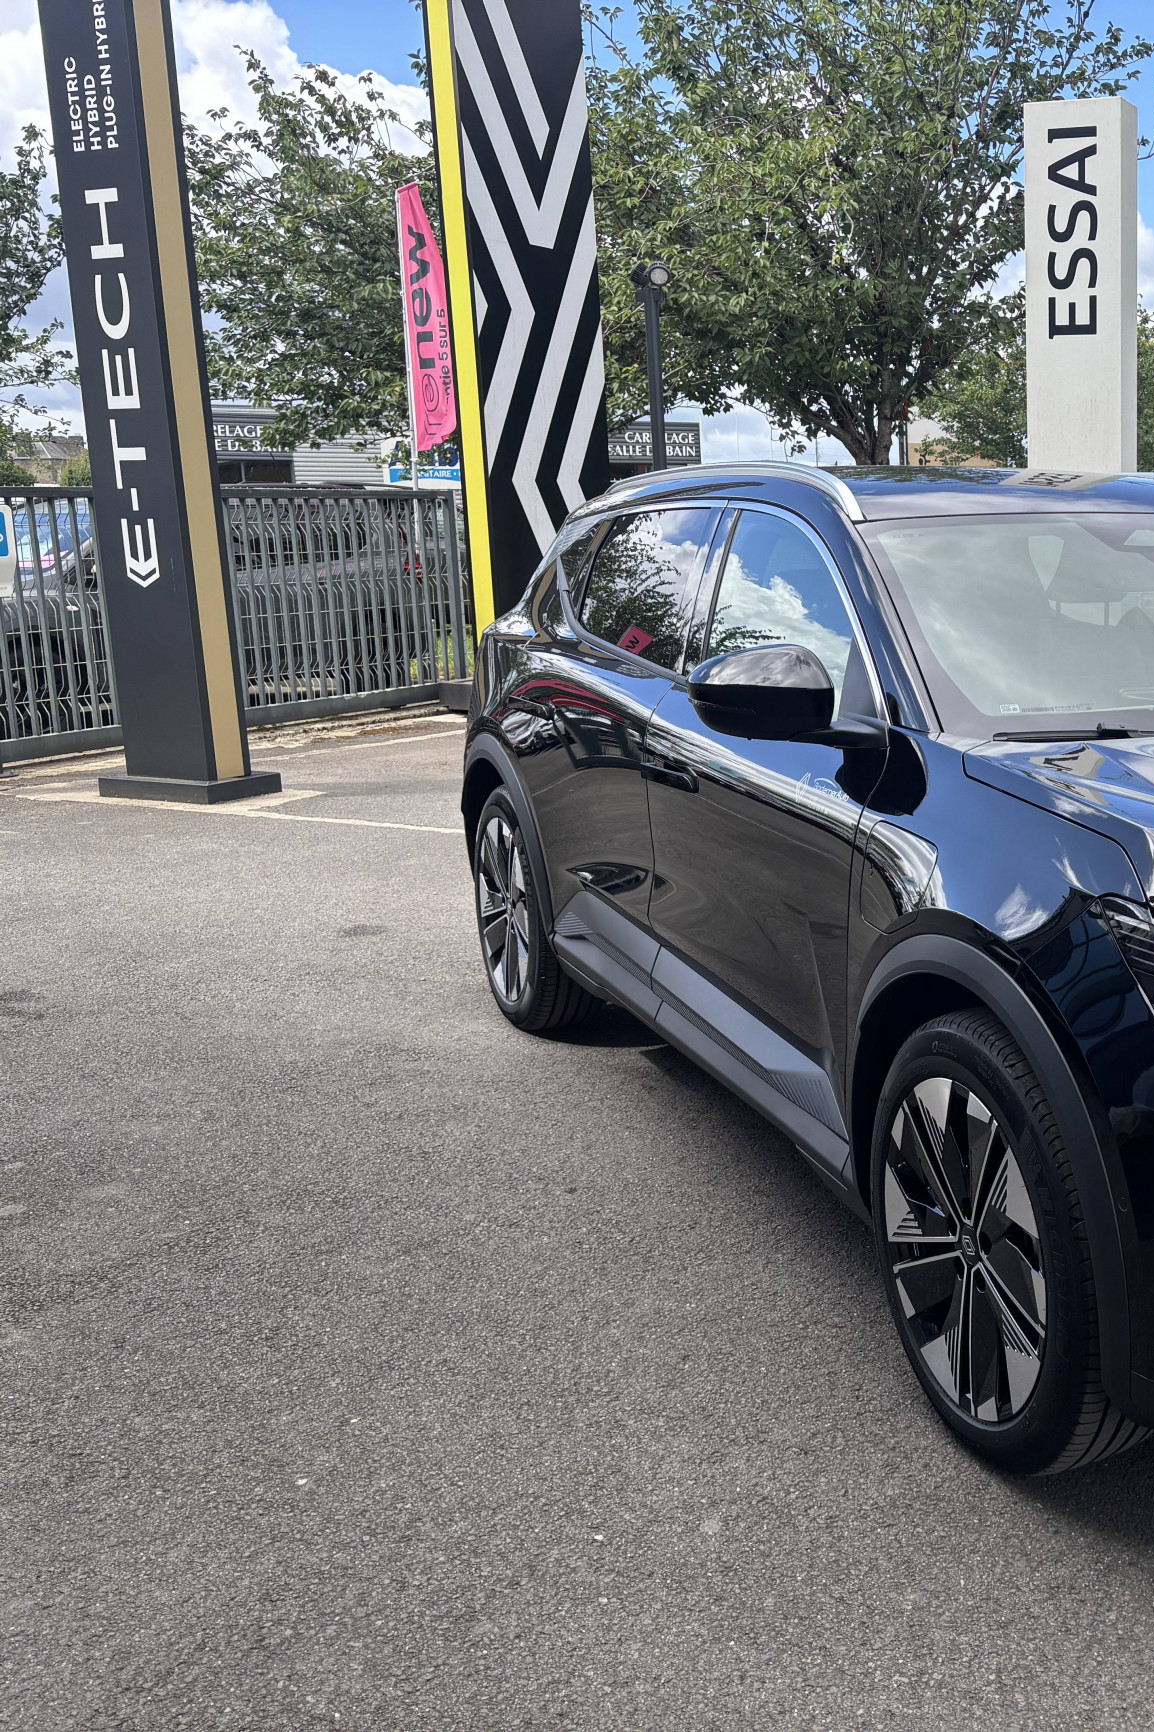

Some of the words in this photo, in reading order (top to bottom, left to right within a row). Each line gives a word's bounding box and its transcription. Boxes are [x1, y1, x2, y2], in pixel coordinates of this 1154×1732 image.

[64, 56, 85, 152] ELECTRIC
[83, 74, 102, 150] HYBRID
[100, 64, 119, 149] PLUG-IN
[1047, 125, 1098, 340] ESSAI
[436, 308, 446, 318] 5
[438, 321, 449, 349] sur
[438, 351, 449, 362] 5
[84, 187, 161, 588] E-TECH
[624, 431, 695, 444] CARLAGE
[666, 445, 696, 457] BAIN
